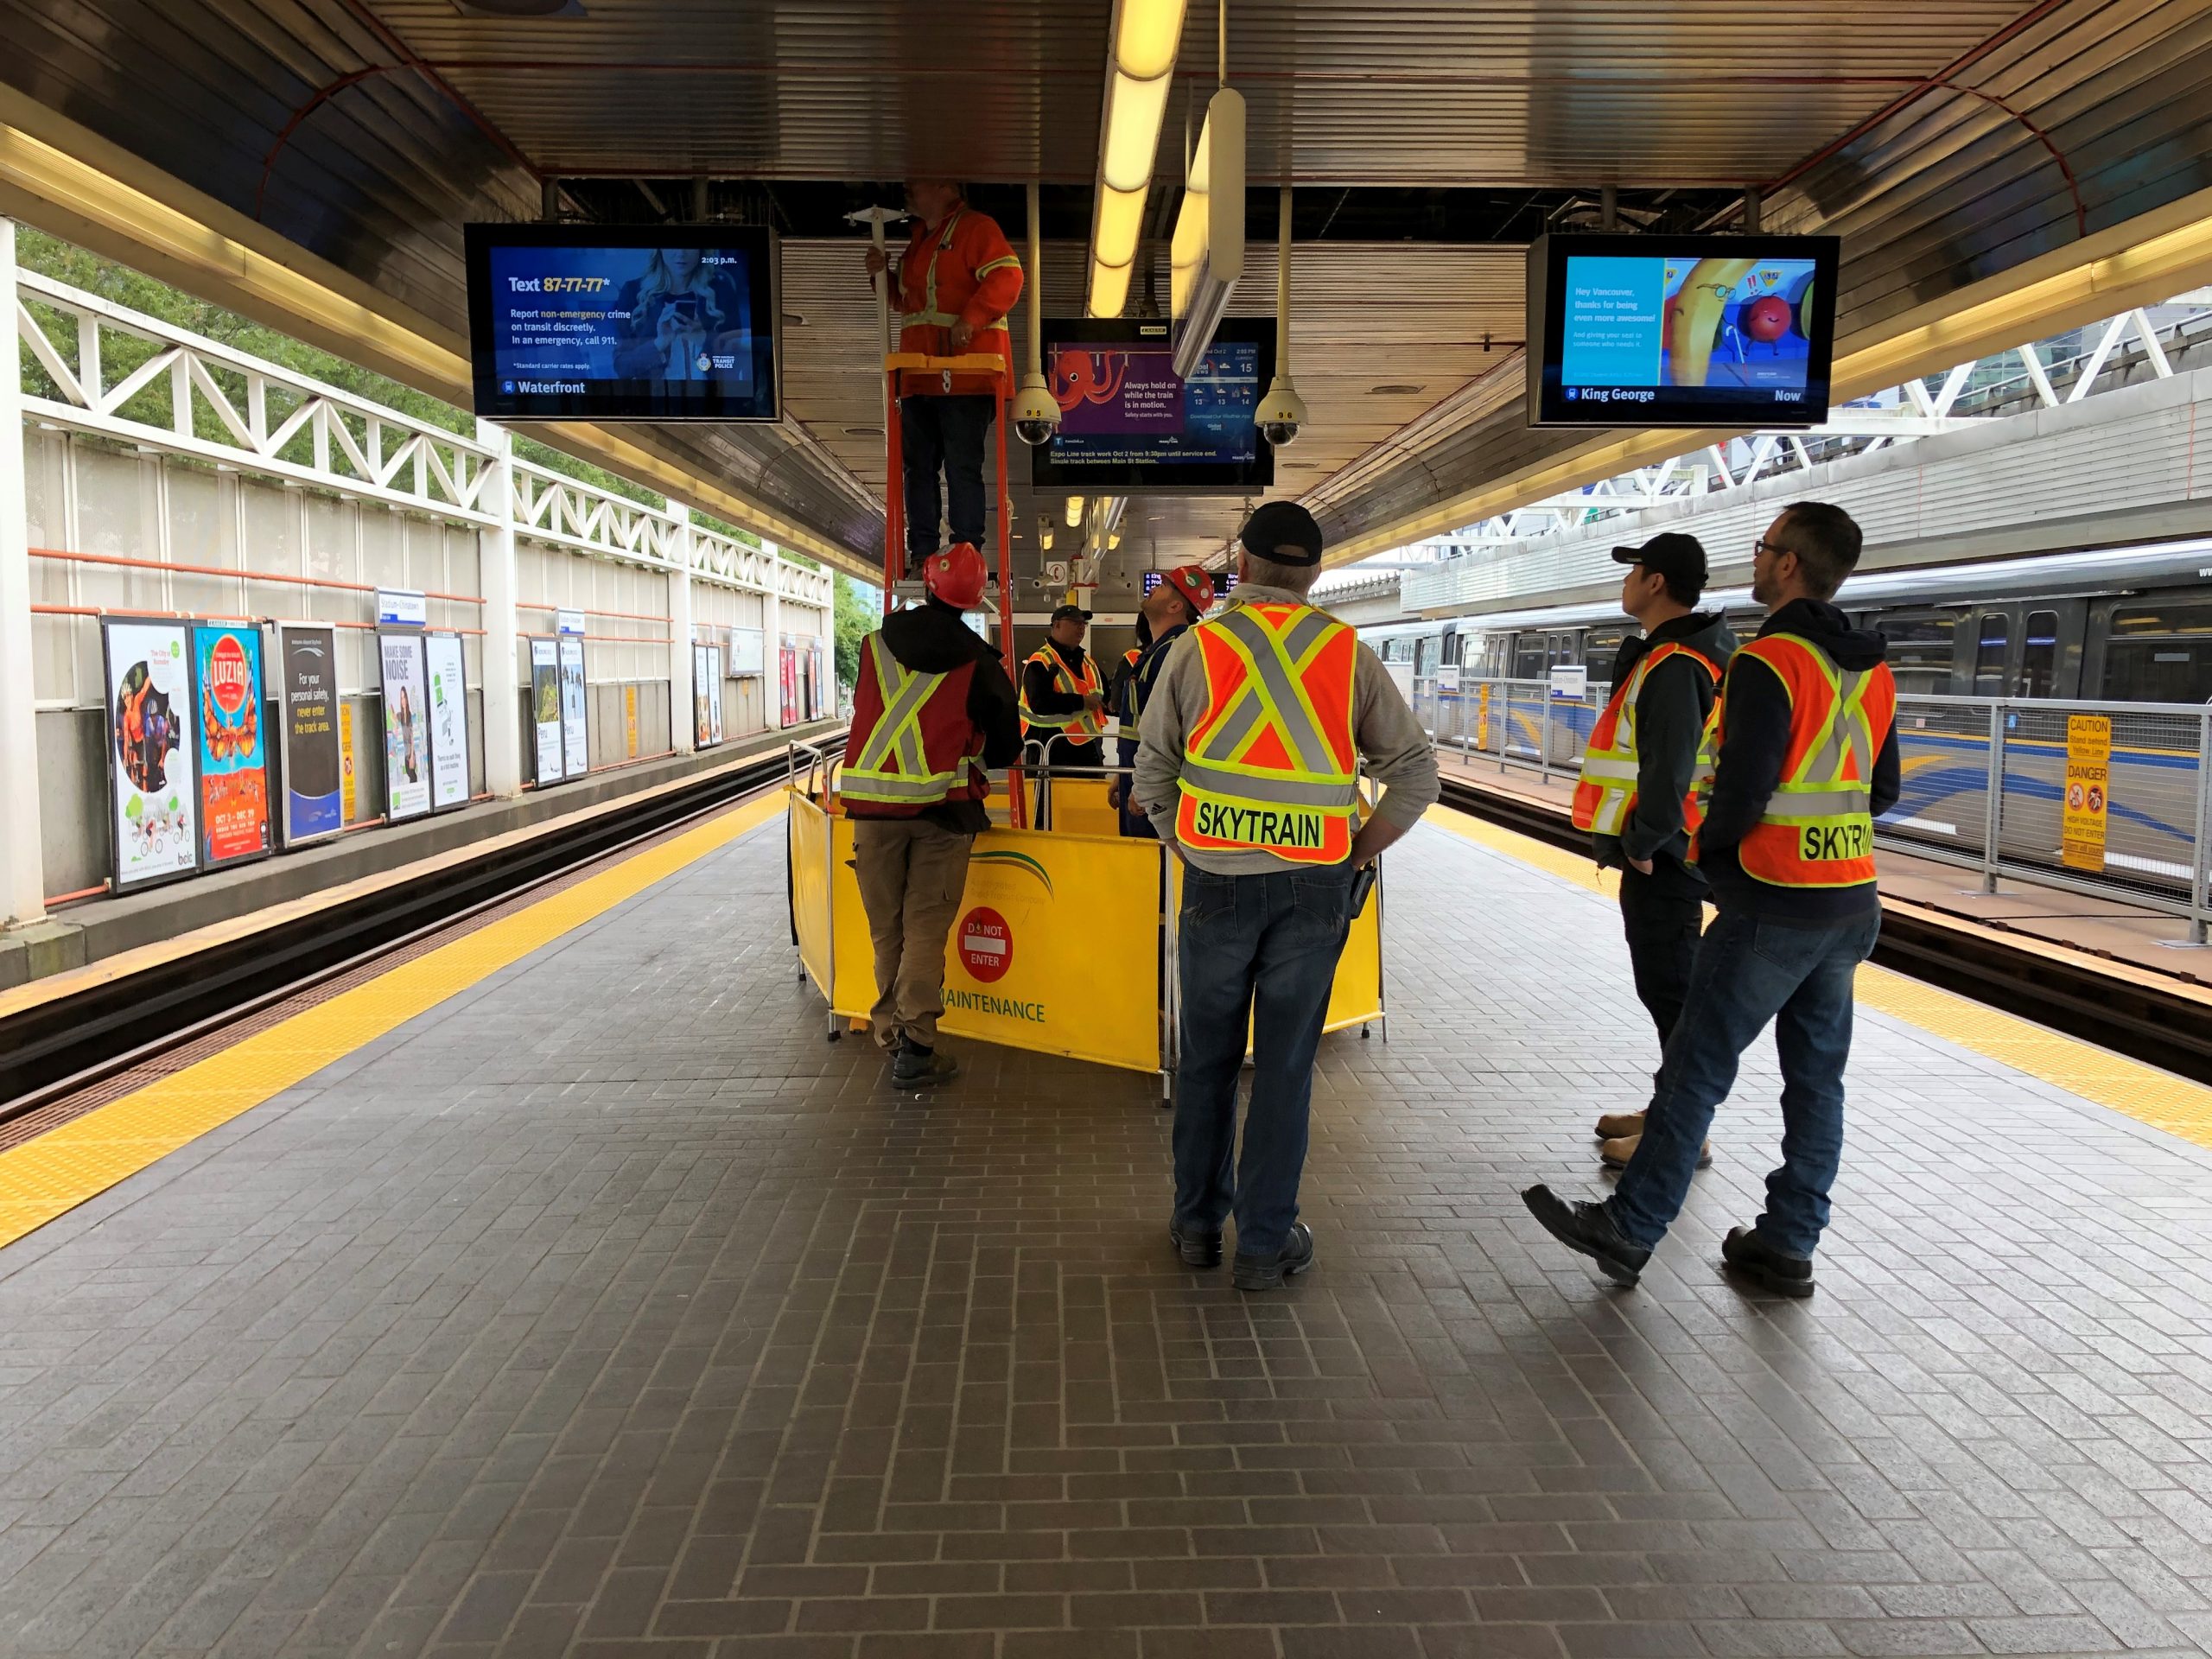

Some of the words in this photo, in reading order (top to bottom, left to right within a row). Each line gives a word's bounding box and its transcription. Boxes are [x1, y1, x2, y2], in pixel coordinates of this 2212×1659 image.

[701, 257, 719, 265] 2:03
[508, 276, 540, 292] Text
[1575, 287, 1591, 297] Hey
[1592, 287, 1635, 297] Vancouver,
[1574, 300, 1601, 309] thanks
[1603, 300, 1614, 309] for
[1616, 301, 1638, 311] being
[510, 308, 539, 320] Report
[540, 309, 606, 321] non-emergency
[607, 309, 631, 319] crime
[1616, 314, 1656, 322] awesome!
[524, 322, 552, 332] transit
[553, 321, 596, 334] discreetly.
[512, 335, 520, 345] In
[535, 337, 583, 346] emergency,
[585, 336, 600, 346] call
[601, 336, 618, 346] 911.
[1240, 363, 1253, 372] 15
[518, 380, 586, 394] Waterfront
[1124, 381, 1149, 391] Always
[1150, 381, 1166, 390] hold
[1124, 391, 1144, 399] while
[1144, 391, 1156, 399] the
[1157, 391, 1173, 399] train
[1581, 387, 1609, 403] King
[1611, 387, 1655, 403] George
[1775, 390, 1802, 402] Now
[384, 645, 398, 658] MAKE
[398, 645, 413, 658] SOME
[213, 660, 245, 687] LUZIA
[385, 658, 410, 681] NOISE
[298, 672, 308, 685] For
[308, 673, 320, 688] your
[290, 688, 313, 704] personal
[313, 687, 330, 702] safety,
[296, 707, 312, 718] never
[312, 705, 326, 716] enter
[294, 721, 304, 735] the
[304, 720, 318, 734] track
[317, 721, 331, 733] area.
[564, 723, 575, 735] Peru
[2069, 718, 2108, 733] CAUTION
[537, 727, 548, 740] Peru
[2069, 735, 2087, 745] Stand
[2088, 736, 2108, 747] behind
[2072, 745, 2090, 754] Yellow
[2091, 747, 2104, 756] Line
[2068, 765, 2107, 781] DANGER
[215, 813, 226, 824] OCT
[236, 810, 246, 820] DEC
[2066, 815, 2080, 824] HIGH
[2080, 817, 2103, 828] VOLTAGE
[1197, 802, 1319, 848] SKYTRAIN
[2063, 825, 2073, 835] DO
[2073, 826, 2085, 837] NOT
[2086, 829, 2105, 840] ENTER
[177, 850, 193, 865] bclc
[983, 925, 1003, 937] NOT
[970, 953, 1000, 967] ENTER
